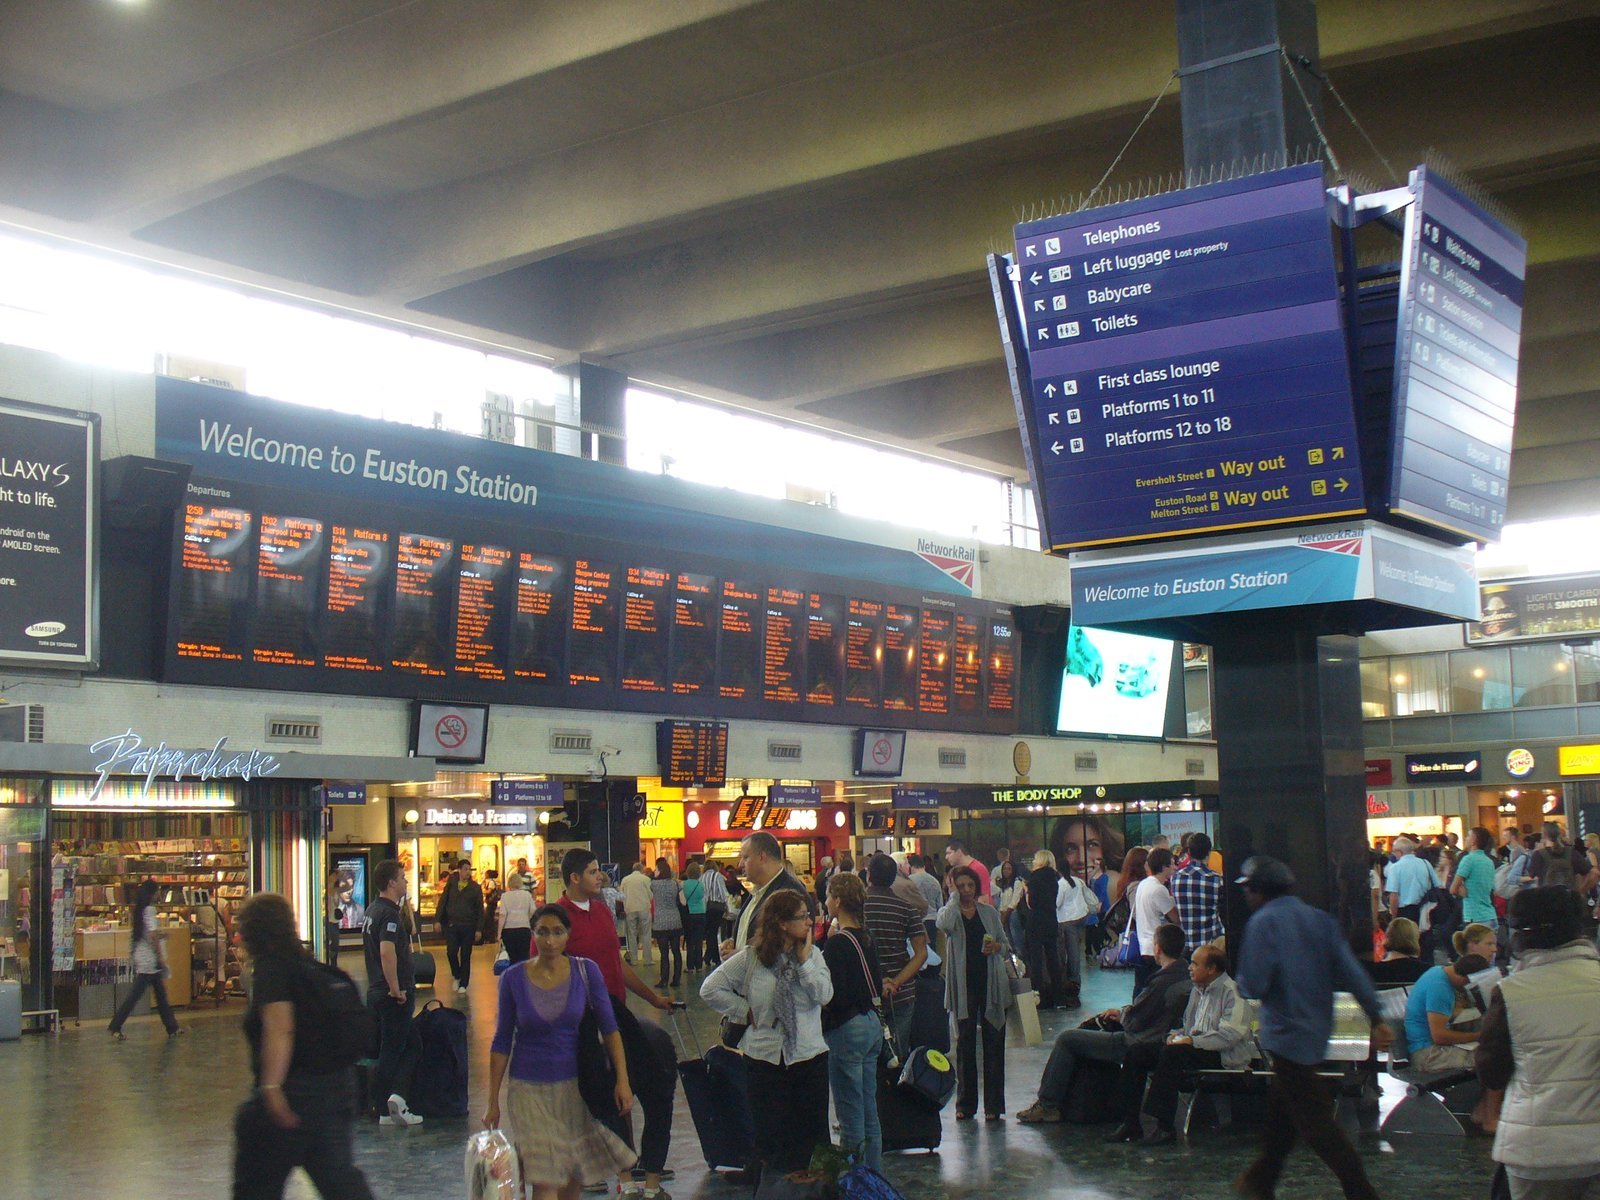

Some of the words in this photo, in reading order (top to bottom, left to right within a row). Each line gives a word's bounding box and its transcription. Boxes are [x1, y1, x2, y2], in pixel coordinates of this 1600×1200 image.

[1083, 221, 1160, 246] Telephones
[1084, 257, 1112, 276] Left
[1116, 249, 1172, 271] luggage
[1174, 248, 1192, 259] Lost
[1194, 241, 1229, 256] property
[1088, 282, 1152, 304] Babycare
[1092, 314, 1138, 332] Toilets
[1098, 373, 1130, 390] First
[1134, 369, 1166, 384] class
[1170, 361, 1220, 378] lounge
[1102, 398, 1170, 418] Platforms
[1173, 393, 1180, 408] 1
[1182, 393, 1198, 406] to
[1201, 388, 1215, 403] 11
[1106, 428, 1174, 448] Platforms
[1176, 422, 1192, 438] 12
[1195, 421, 1211, 434] to
[1214, 416, 1232, 432] 18
[200, 419, 322, 470] Welcome
[331, 446, 356, 475] to
[363, 449, 448, 491] Euston
[454, 466, 538, 506] Station
[0, 457, 51, 482] LAXY
[52, 462, 70, 487] S
[1136, 472, 1176, 488] Eversholt
[1178, 470, 1204, 482] Street
[1220, 460, 1253, 476] Way
[1258, 455, 1286, 471] out
[187, 484, 230, 498] Departures
[1155, 496, 1184, 507] Euston
[1186, 493, 1206, 503] Road
[1224, 490, 1256, 506] Way
[1262, 485, 1290, 501] out
[17, 491, 30, 504] to
[34, 492, 56, 508] life.
[211, 508, 240, 520] Platform
[1150, 508, 1180, 519] Melton
[1182, 505, 1208, 516] Street
[285, 519, 314, 531] Platform
[26, 530, 36, 539] on
[38, 530, 50, 540] the
[200, 527, 227, 538] boarding
[354, 529, 380, 541] Platform
[1298, 529, 1364, 544] NetworkRail
[2, 540, 32, 551] AMOLED
[274, 537, 300, 548] boarding
[420, 538, 445, 550] Platform
[918, 538, 975, 560] NetworkRail
[344, 546, 368, 558] boarding
[481, 546, 505, 558] Platform
[398, 562, 412, 570] Calling
[410, 556, 433, 566] boarding
[1085, 584, 1150, 603] Welcome
[1154, 582, 1168, 596] to
[1172, 577, 1226, 596] Euston
[1230, 570, 1288, 590] Station
[1526, 592, 1564, 602] LIGHTLY
[1527, 603, 1544, 612] FOR
[1546, 602, 1554, 610] A
[1554, 598, 1598, 610] SMOOTH
[30, 625, 60, 633] SAMSUNG
[200, 644, 220, 652] Trains
[90, 728, 280, 802] Paperchase
[1411, 765, 1432, 773] Delice
[1432, 764, 1442, 772] de
[1442, 762, 1465, 770] France
[514, 782, 534, 790] Platforms
[992, 790, 1014, 802] THE
[1017, 788, 1049, 801] BODY
[1050, 788, 1082, 800] SHOP
[426, 808, 467, 824] Delice
[468, 808, 484, 824] de
[485, 809, 527, 824] France
[867, 815, 874, 828] 7
